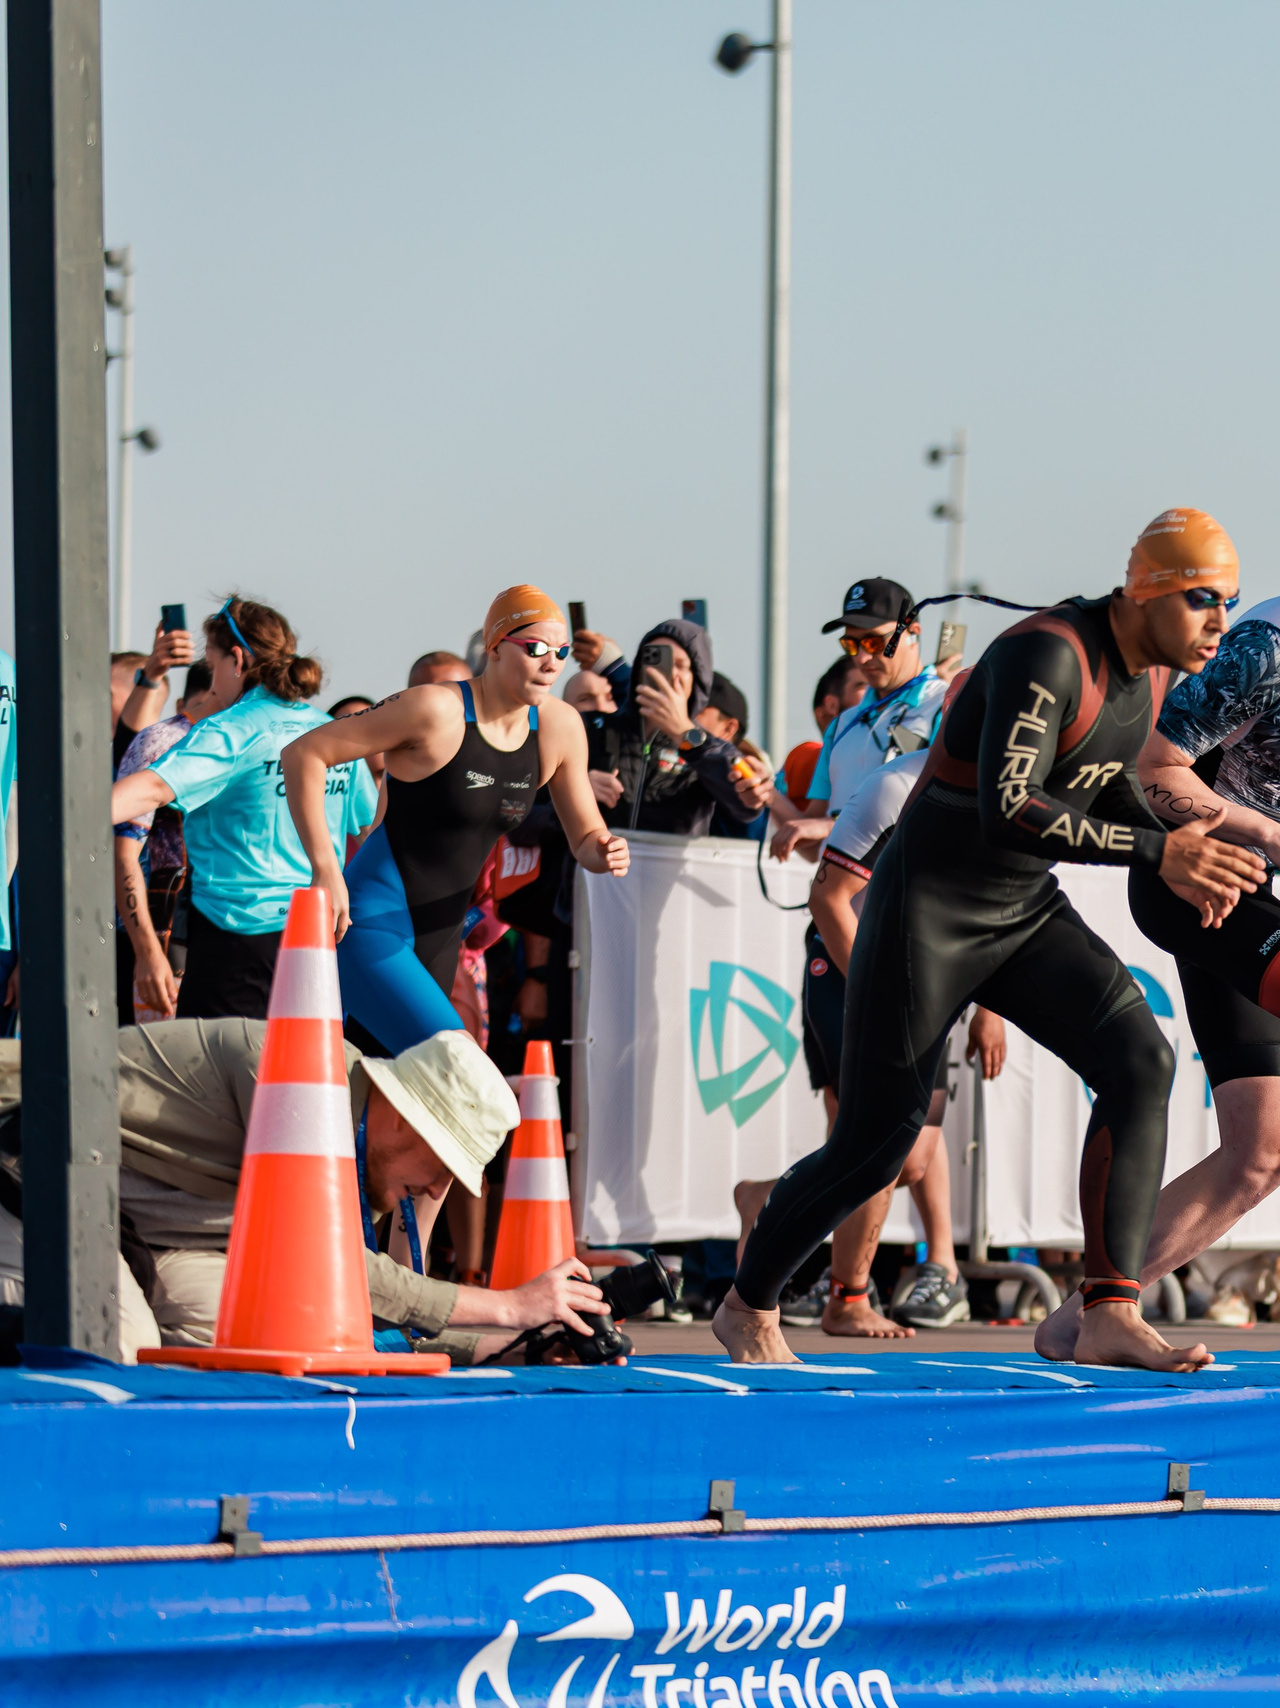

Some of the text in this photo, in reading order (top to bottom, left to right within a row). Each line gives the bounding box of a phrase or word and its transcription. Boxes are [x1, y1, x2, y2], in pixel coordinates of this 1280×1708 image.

[466, 770, 495, 786] speedo
[654, 1584, 847, 1655] World
[630, 1657, 900, 1708] Triathlon
